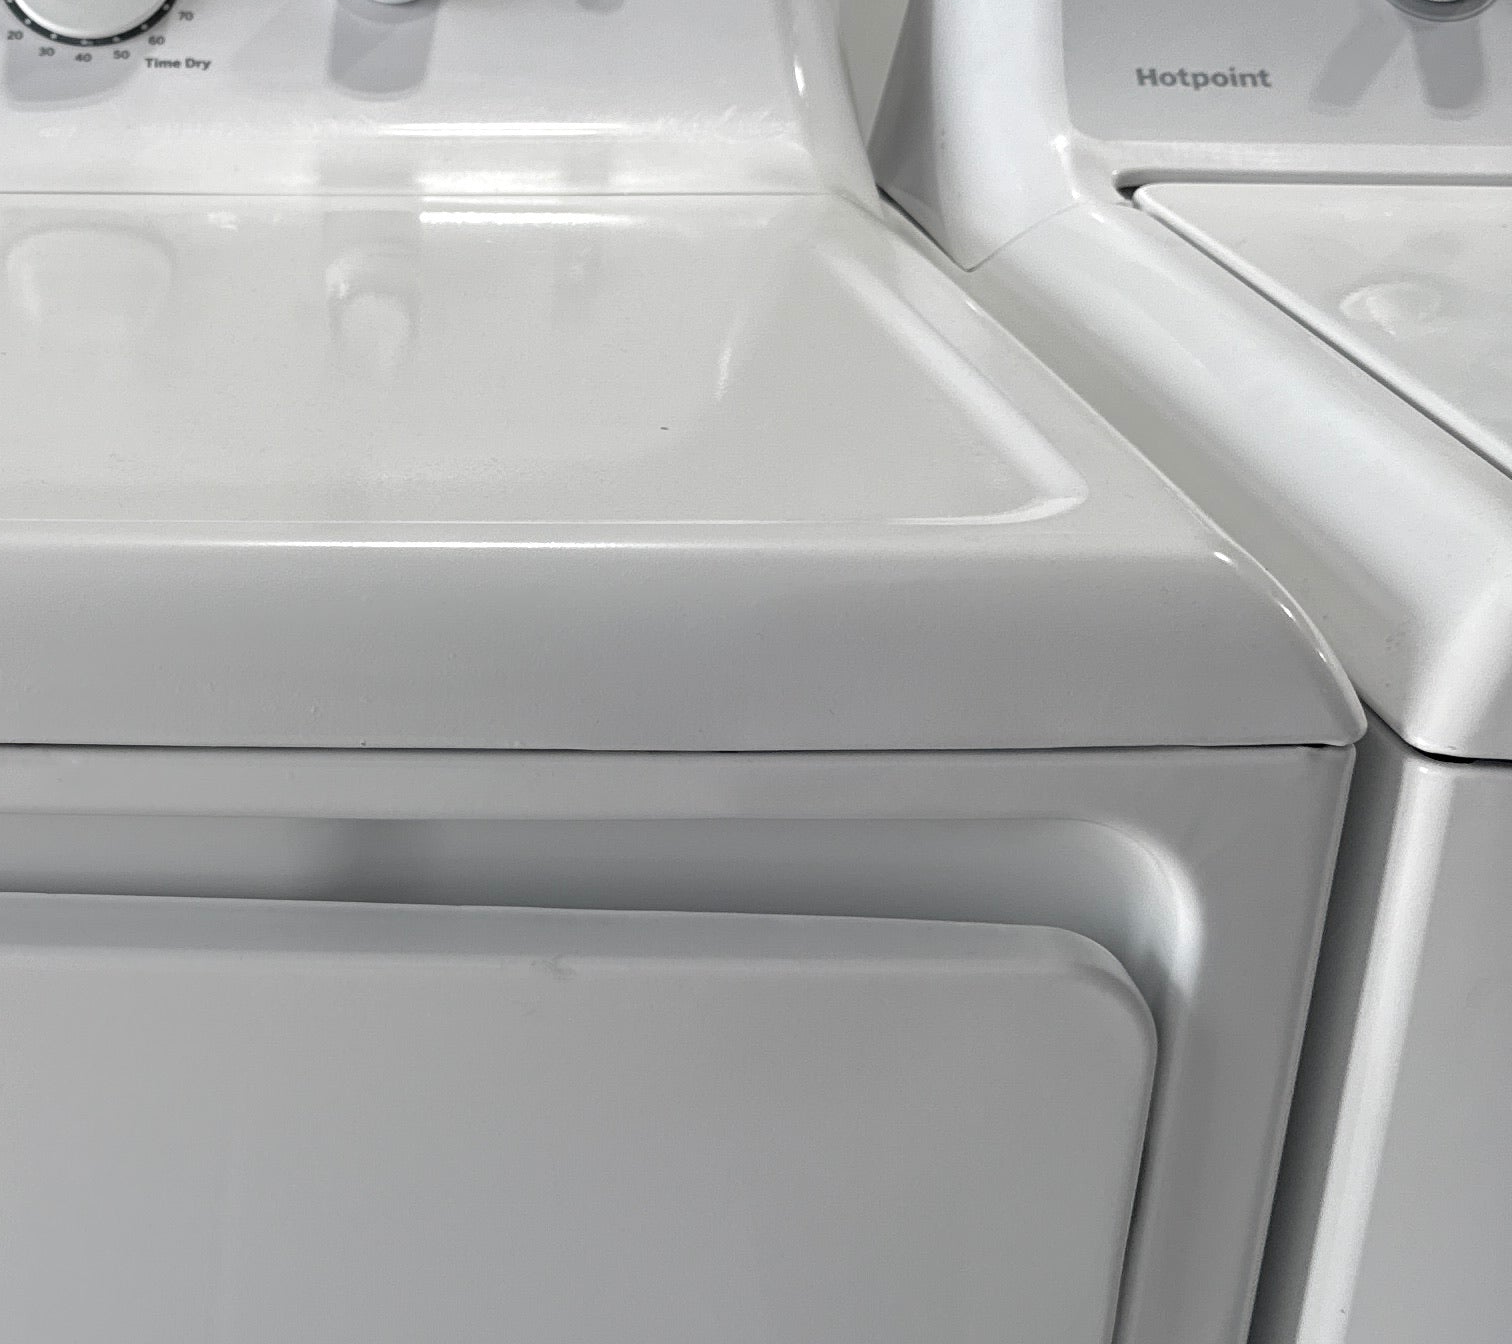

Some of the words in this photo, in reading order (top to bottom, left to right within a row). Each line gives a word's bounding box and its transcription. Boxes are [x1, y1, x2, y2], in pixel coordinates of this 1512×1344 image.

[178, 11, 194, 21] 70
[7, 30, 24, 40] 20
[148, 36, 165, 46] 60
[39, 47, 55, 57] 30
[113, 50, 130, 60] 50
[75, 53, 92, 63] 40
[144, 58, 181, 69] Time
[184, 58, 211, 71] Dry
[1136, 67, 1272, 91] Hotpoint
